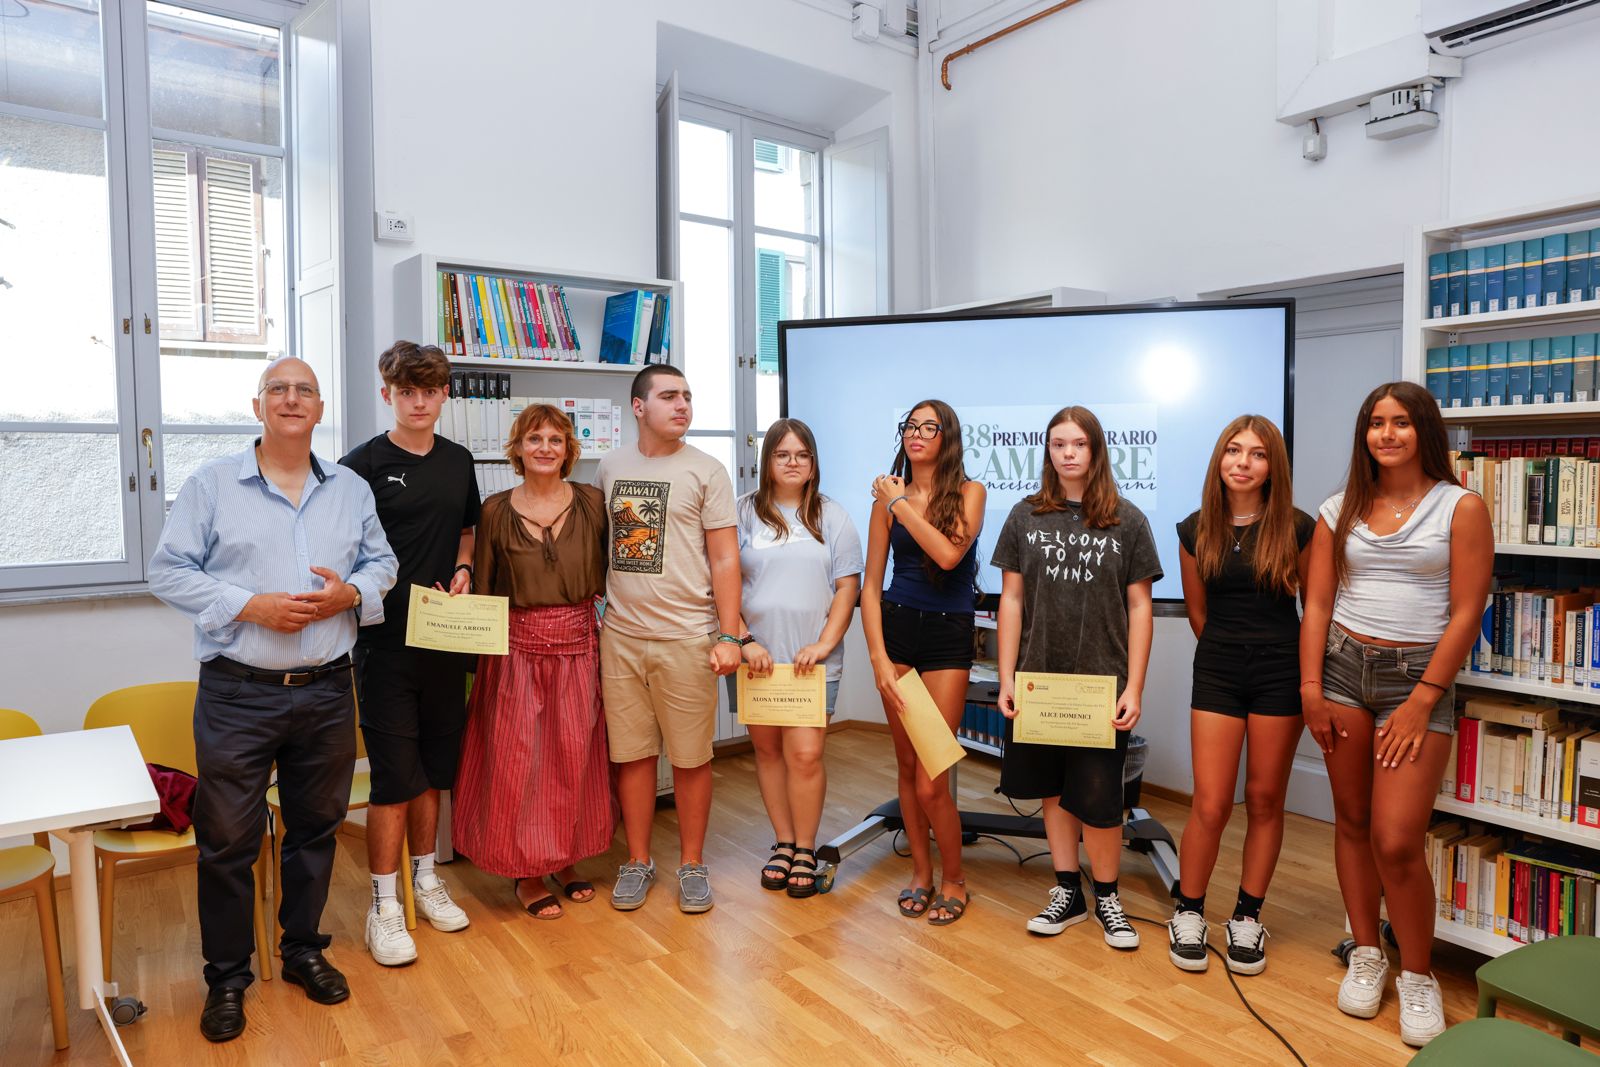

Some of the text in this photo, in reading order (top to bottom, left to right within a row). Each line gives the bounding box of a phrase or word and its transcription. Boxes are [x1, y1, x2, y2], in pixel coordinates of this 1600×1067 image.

[619, 485, 659, 497] HAWAII
[1026, 529, 1121, 555] WELCOME
[1041, 544, 1104, 567] TO MY
[1046, 563, 1094, 584] MIND
[426, 621, 461, 631] EMANUELE
[1039, 711, 1092, 720] ALICE DOMENICI
